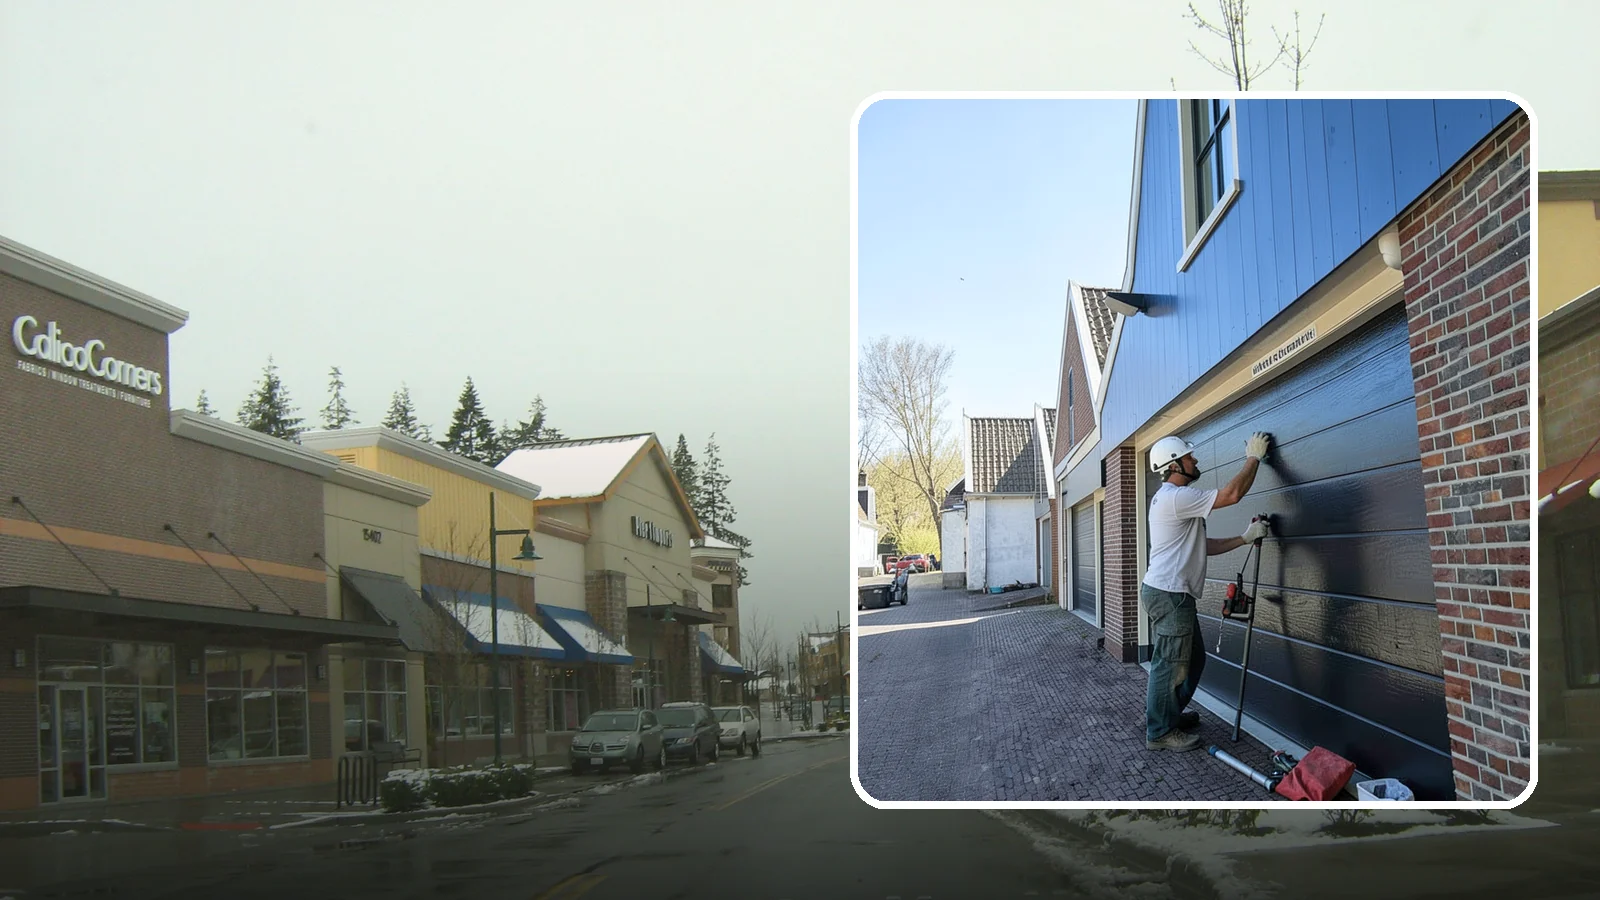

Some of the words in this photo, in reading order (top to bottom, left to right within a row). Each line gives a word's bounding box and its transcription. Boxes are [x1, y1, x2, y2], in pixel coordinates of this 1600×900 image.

[16, 360, 47, 378] FABRICS
[51, 370, 78, 387] WINDOW
[79, 379, 116, 398] TREATMENTS
